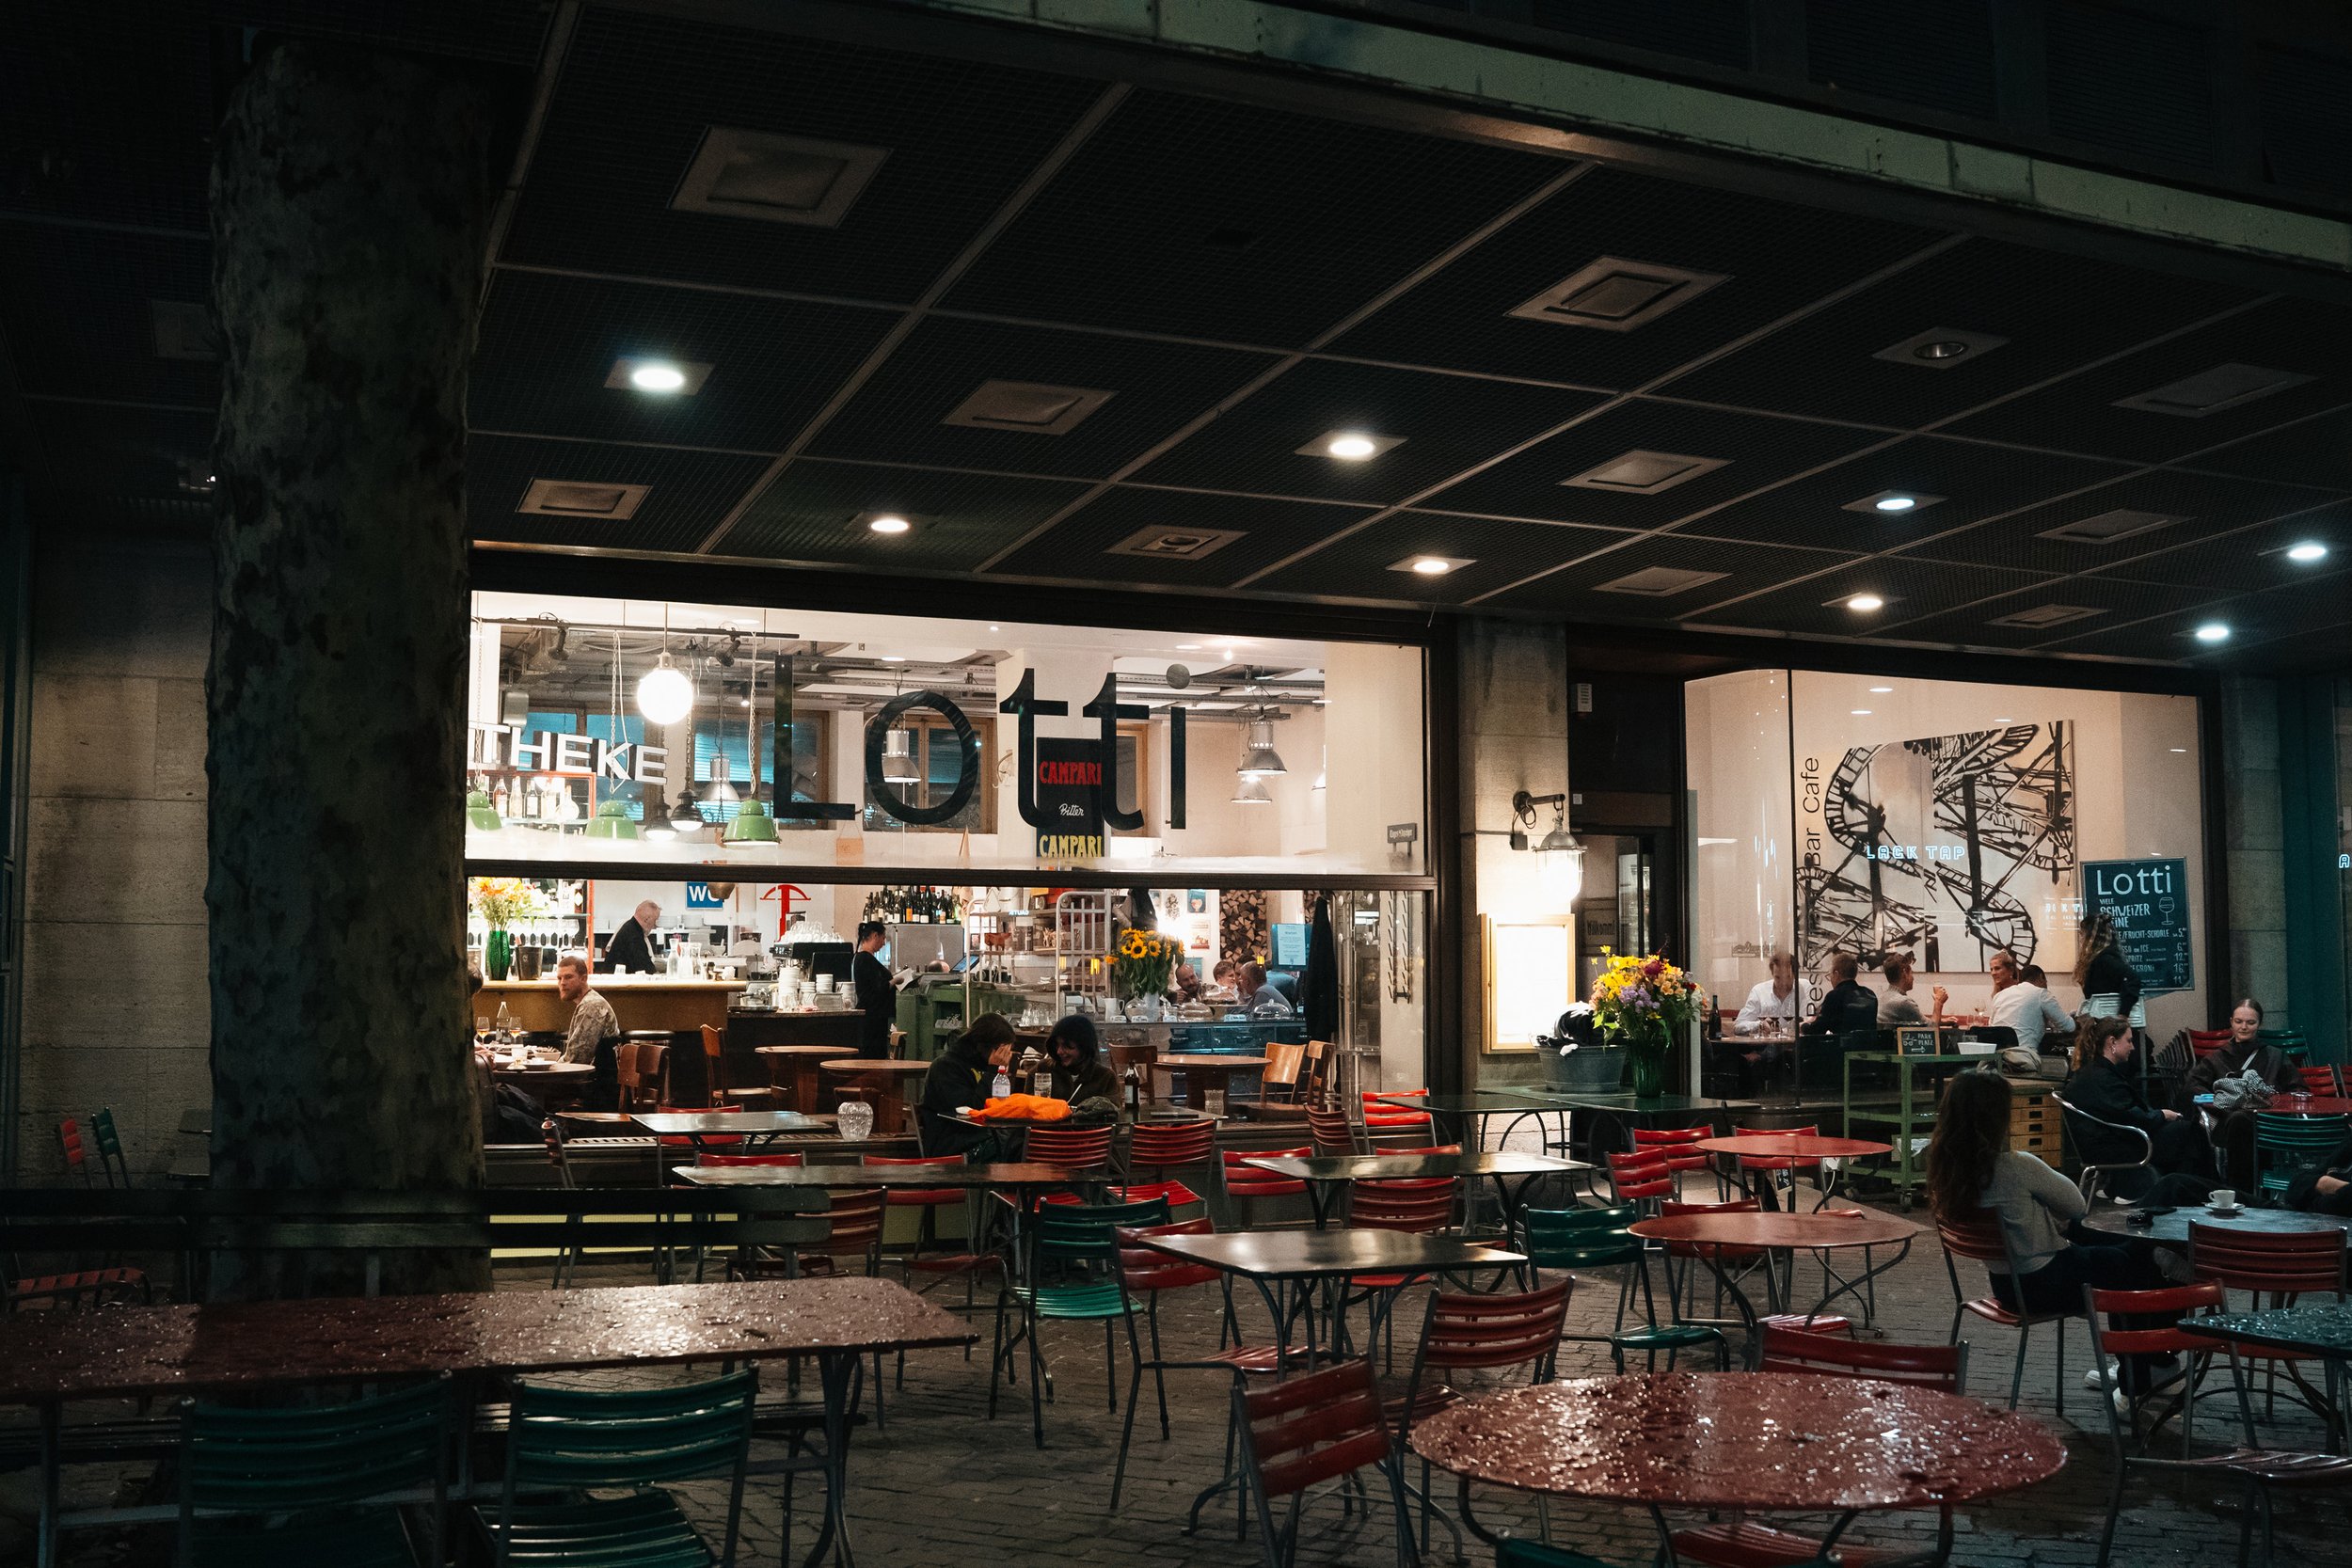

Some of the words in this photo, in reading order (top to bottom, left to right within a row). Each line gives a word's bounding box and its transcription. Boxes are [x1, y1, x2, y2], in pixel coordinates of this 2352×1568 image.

[469, 721, 669, 784] THEKE
[1039, 760, 1103, 785] CAMPARI
[1801, 757, 1820, 814] Cafe
[1058, 803, 1085, 816] Bitter
[1039, 834, 1103, 858] CAMPARI
[1925, 845, 1965, 860] TAP
[2096, 865, 2171, 895] Lotti
